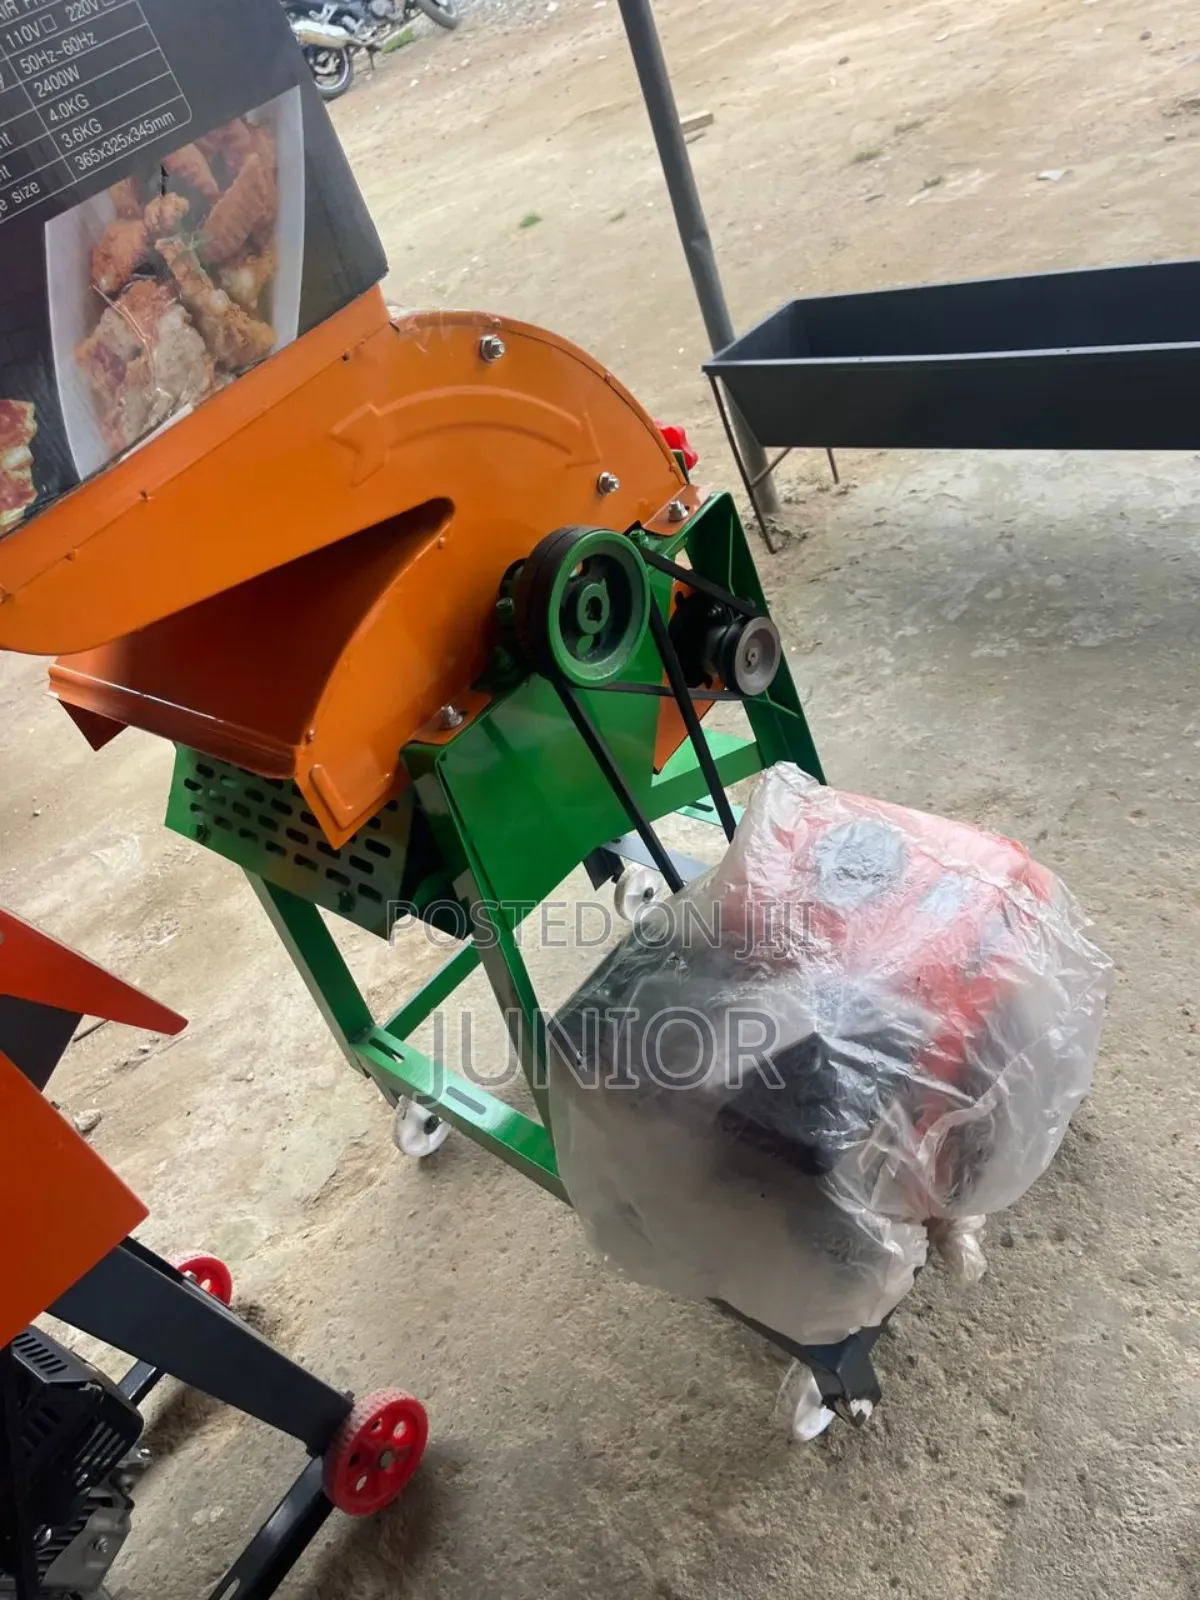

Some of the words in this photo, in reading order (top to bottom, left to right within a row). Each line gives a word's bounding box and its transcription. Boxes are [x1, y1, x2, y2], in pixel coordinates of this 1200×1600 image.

[6, 21, 41, 48] 110V
[64, 0, 99, 21] 220V
[34, 64, 80, 97] 2400W
[49, 93, 90, 121] 4.0KG
[61, 118, 103, 148] 3.6KG
[74, 111, 176, 170] 365x325x345mm
[11, 181, 40, 203] size
